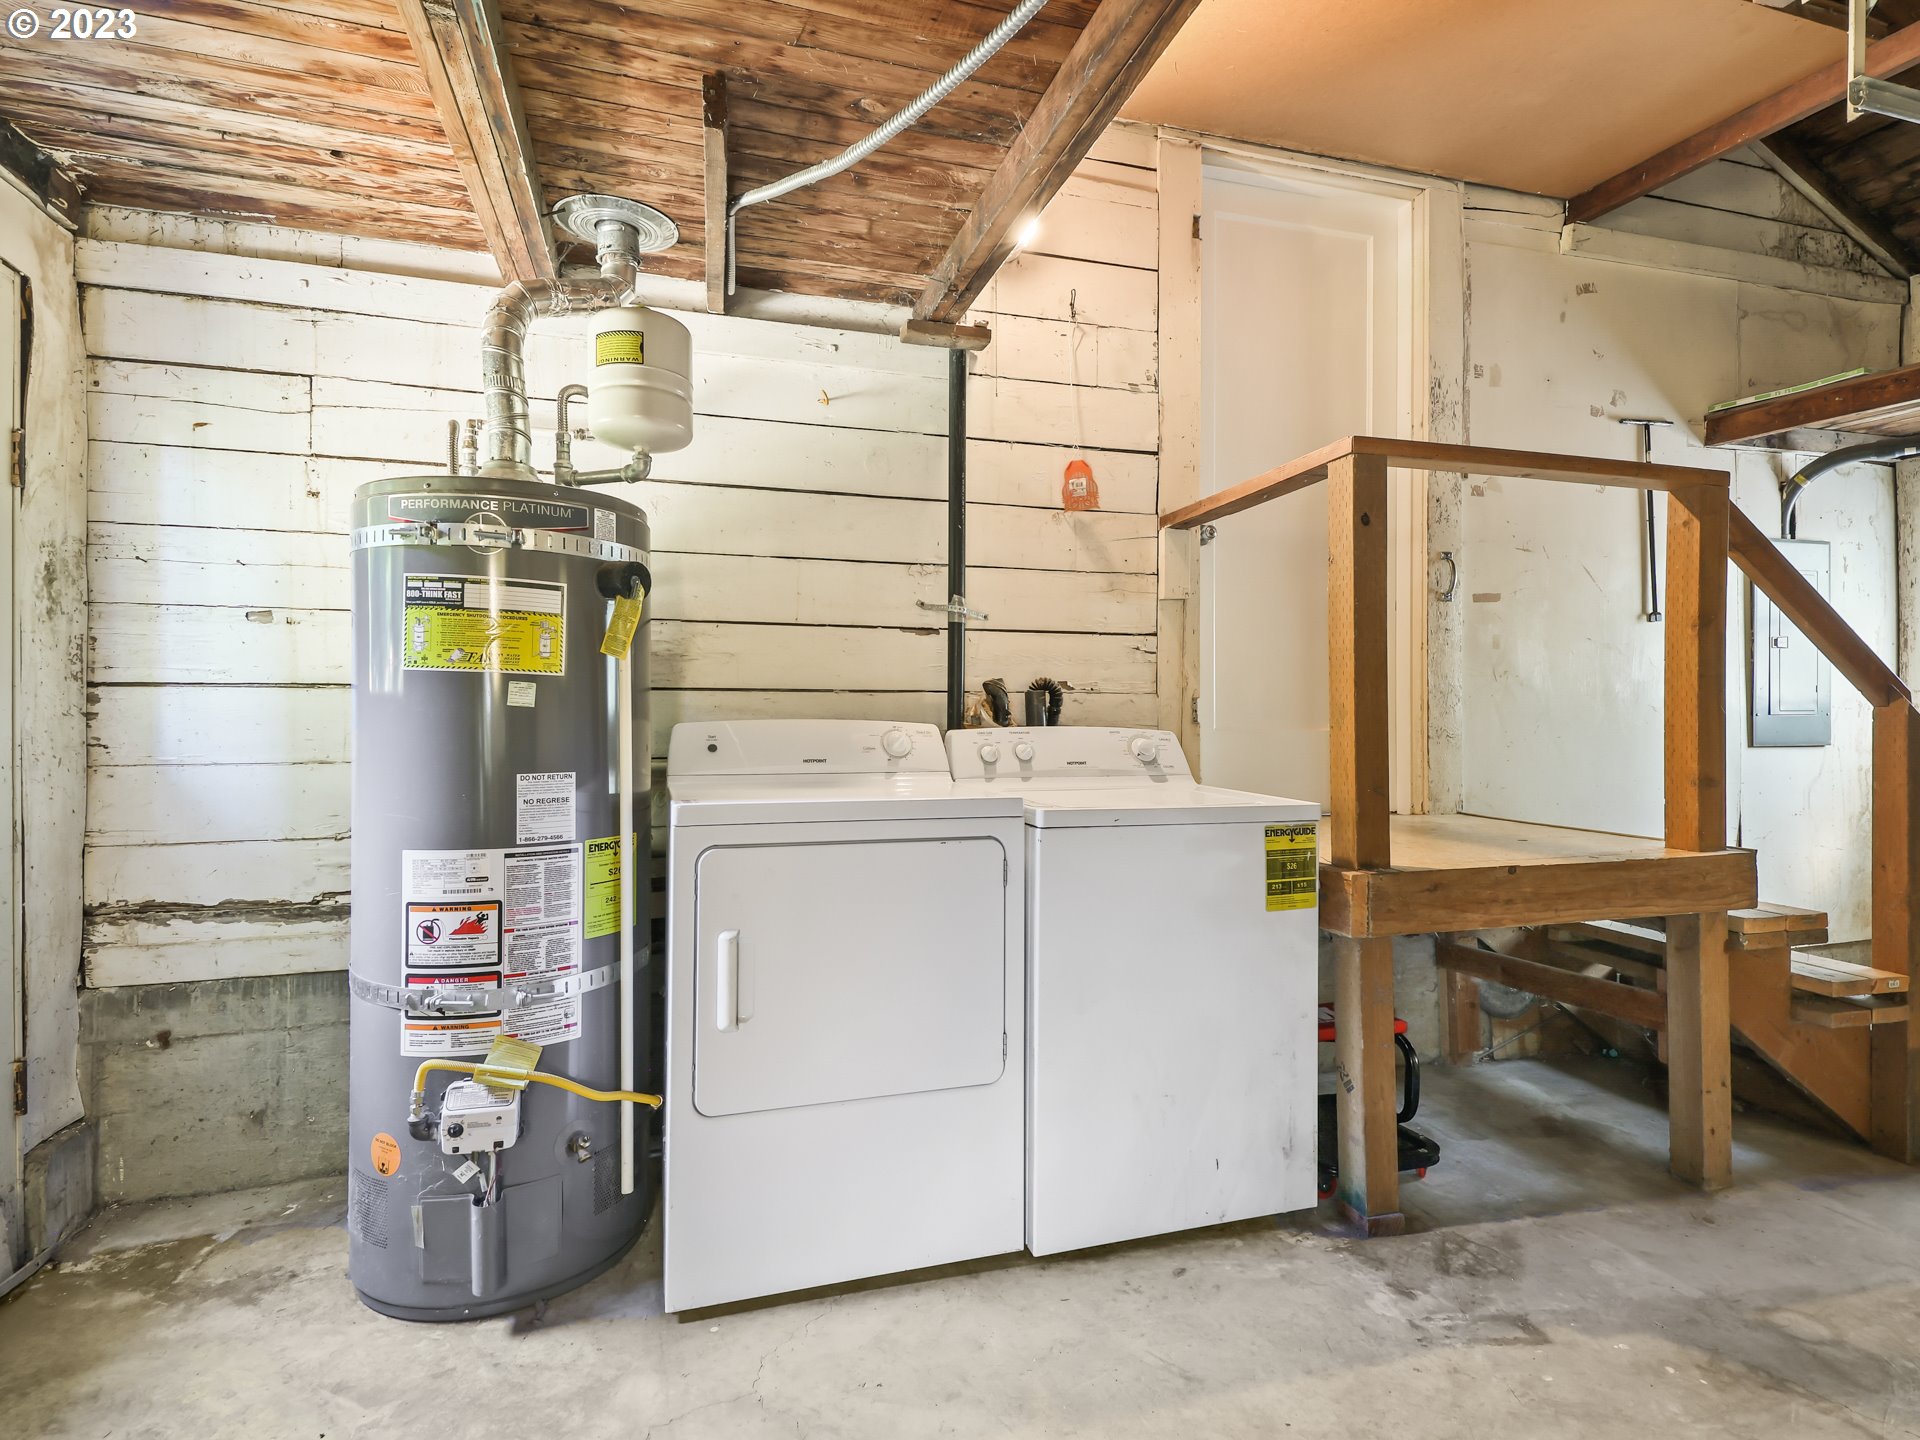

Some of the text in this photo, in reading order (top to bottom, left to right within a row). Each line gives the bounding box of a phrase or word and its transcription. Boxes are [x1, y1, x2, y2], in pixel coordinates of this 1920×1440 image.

[401, 499, 573, 518] PERFORMANCE PLATINUM
[406, 589, 443, 598] 800-THINK
[444, 591, 462, 599] FAST
[1265, 826, 1316, 838] ENERGYGUIDE
